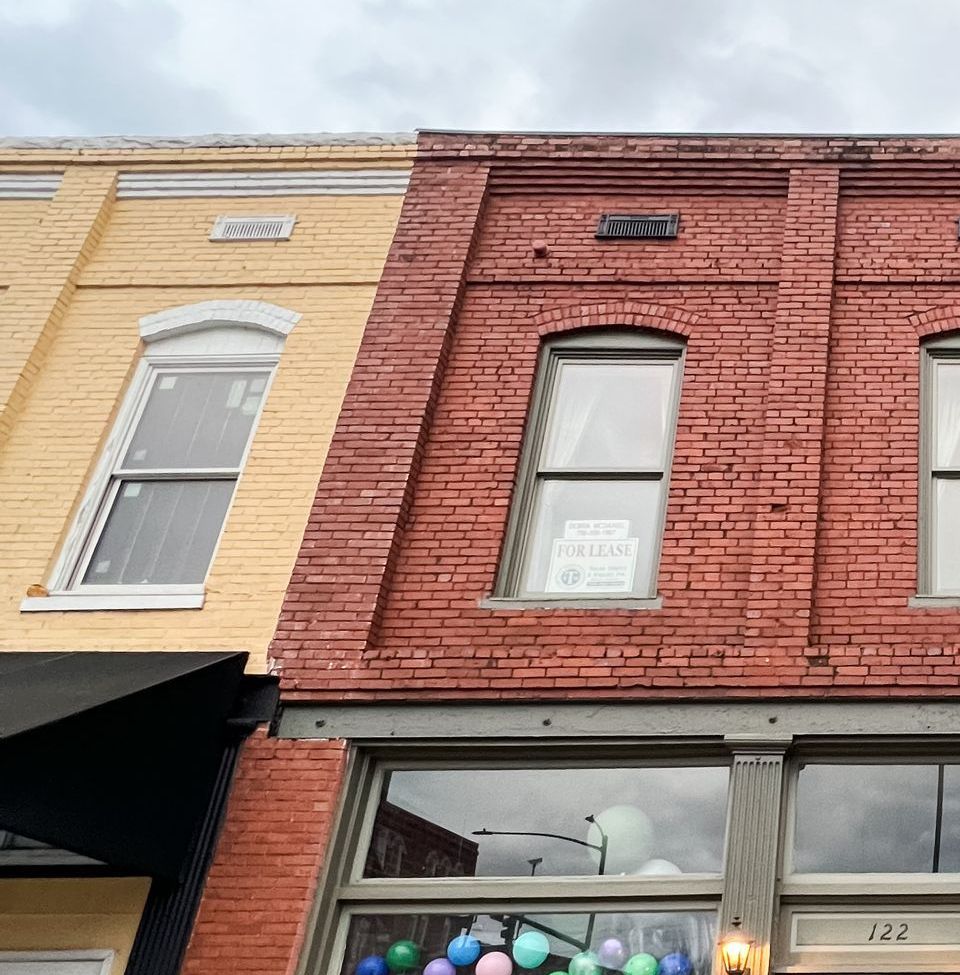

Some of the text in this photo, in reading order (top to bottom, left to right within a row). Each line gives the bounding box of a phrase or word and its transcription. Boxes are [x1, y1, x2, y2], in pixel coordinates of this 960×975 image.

[557, 543, 633, 558] FOR LEASE
[868, 923, 909, 941] 122
